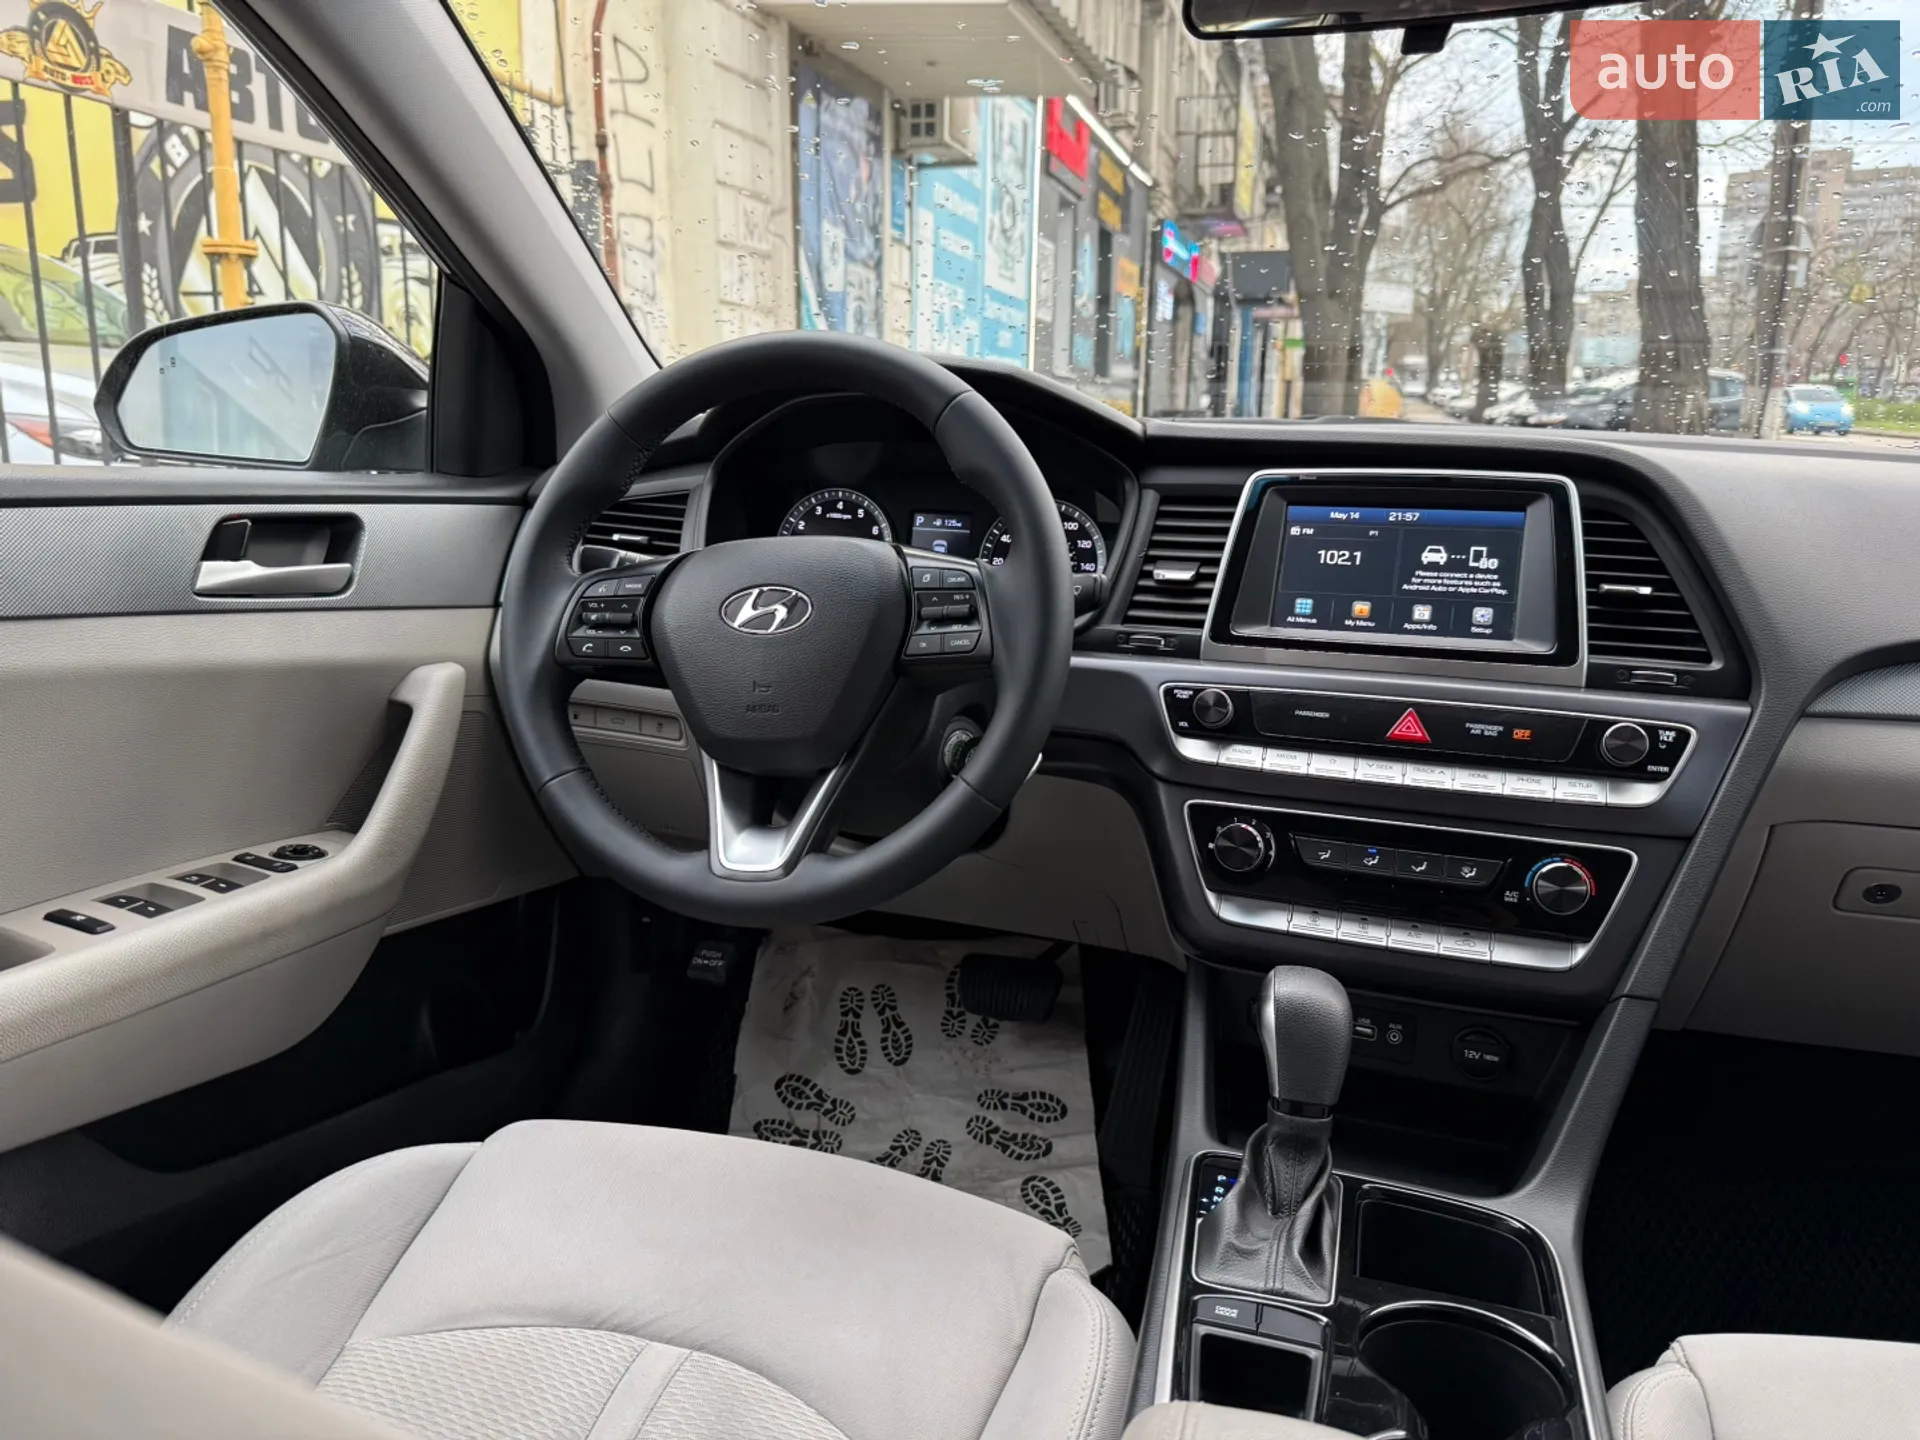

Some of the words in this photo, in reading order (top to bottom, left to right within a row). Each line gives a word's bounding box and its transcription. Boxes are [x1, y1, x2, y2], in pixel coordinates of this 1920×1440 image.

[1329, 512, 1347, 520] May
[1388, 512, 1420, 521] 21:57
[1077, 540, 1092, 548] 120
[1317, 549, 1362, 566] 102.1
[1080, 563, 1096, 571] 140
[1439, 571, 1468, 579] connect
[1463, 1049, 1481, 1060] 12V
